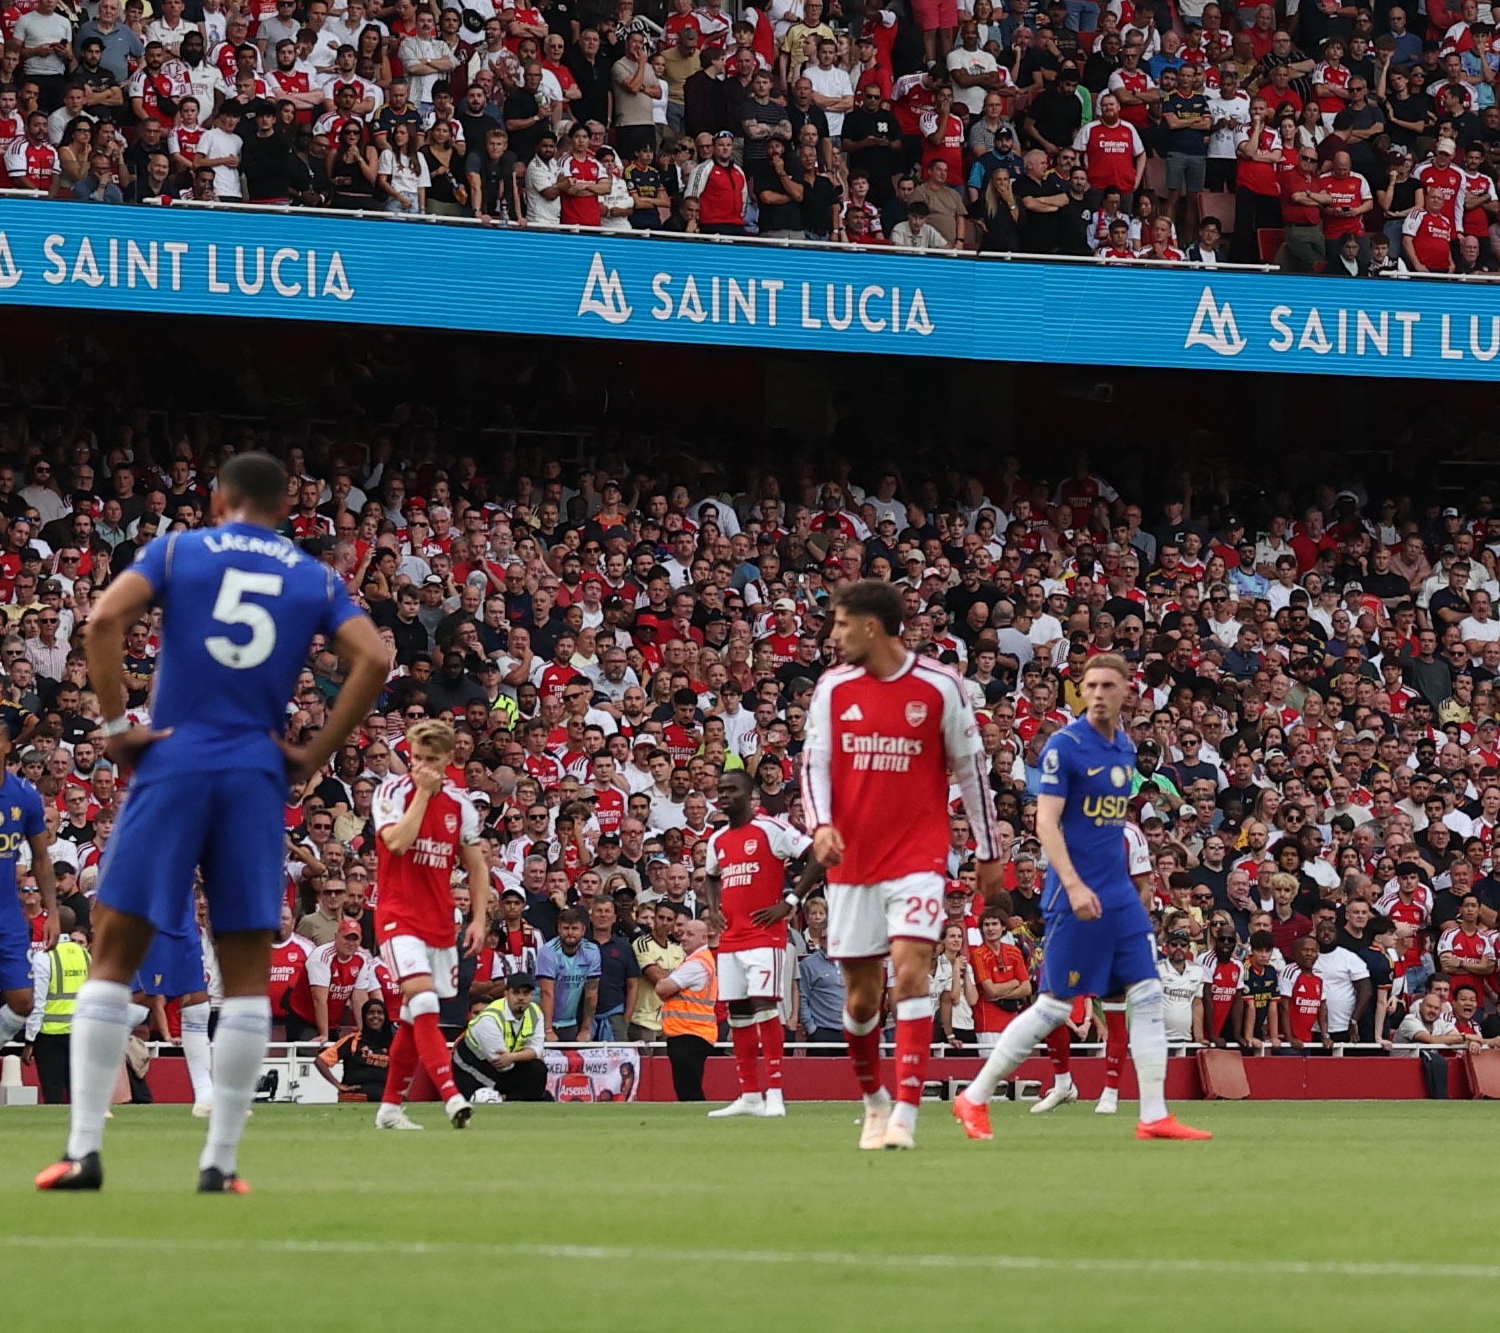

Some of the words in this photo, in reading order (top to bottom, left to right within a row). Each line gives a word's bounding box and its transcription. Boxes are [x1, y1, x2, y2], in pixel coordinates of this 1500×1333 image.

[42, 233, 189, 291] SAINT
[207, 243, 355, 302] LUCIA
[651, 271, 784, 327] SAINT
[801, 279, 935, 336] LUCIA
[1269, 304, 1420, 358] SAINT
[204, 566, 284, 670] 5
[841, 731, 924, 756] Emirates
[853, 754, 871, 770] FLY
[872, 754, 912, 773] BETTER
[905, 895, 942, 928] 29
[759, 970, 772, 990] 7
[560, 1084, 590, 1096] Arsenal
